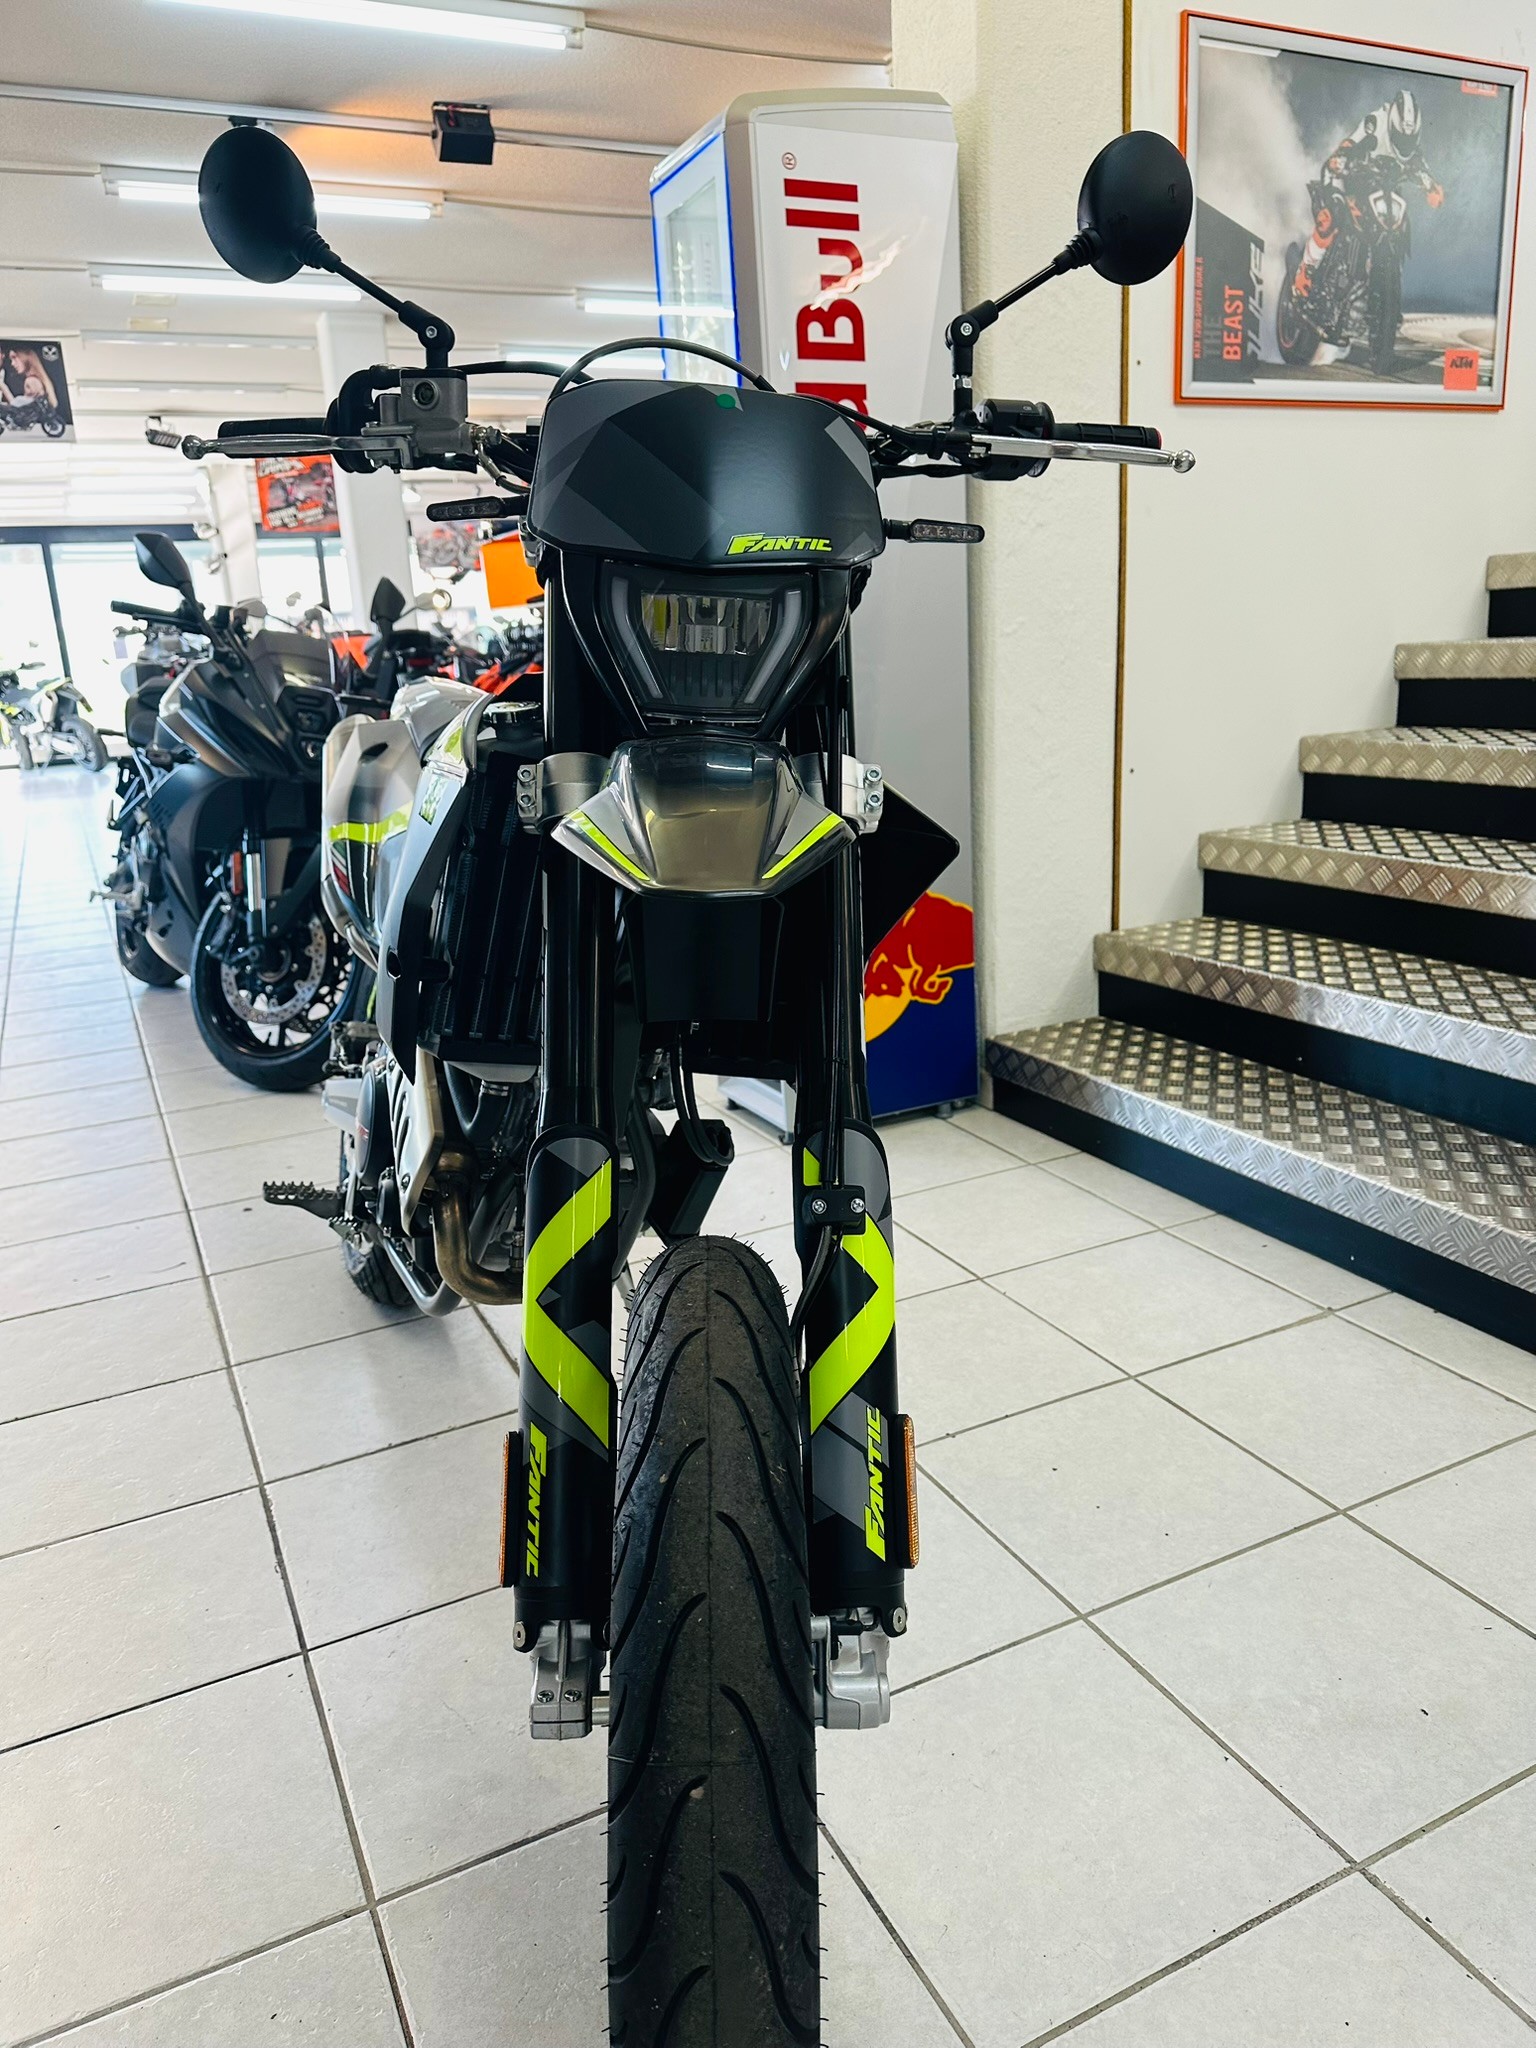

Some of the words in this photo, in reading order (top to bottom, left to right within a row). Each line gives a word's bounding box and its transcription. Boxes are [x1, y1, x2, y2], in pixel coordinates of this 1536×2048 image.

[784, 178, 866, 362] Bull
[1222, 284, 1245, 361] BEAST
[1450, 355, 1474, 369] KTM
[727, 533, 832, 555] FANTIC
[526, 1421, 548, 1578] FANTIC
[865, 1405, 886, 1562] FANTIC
